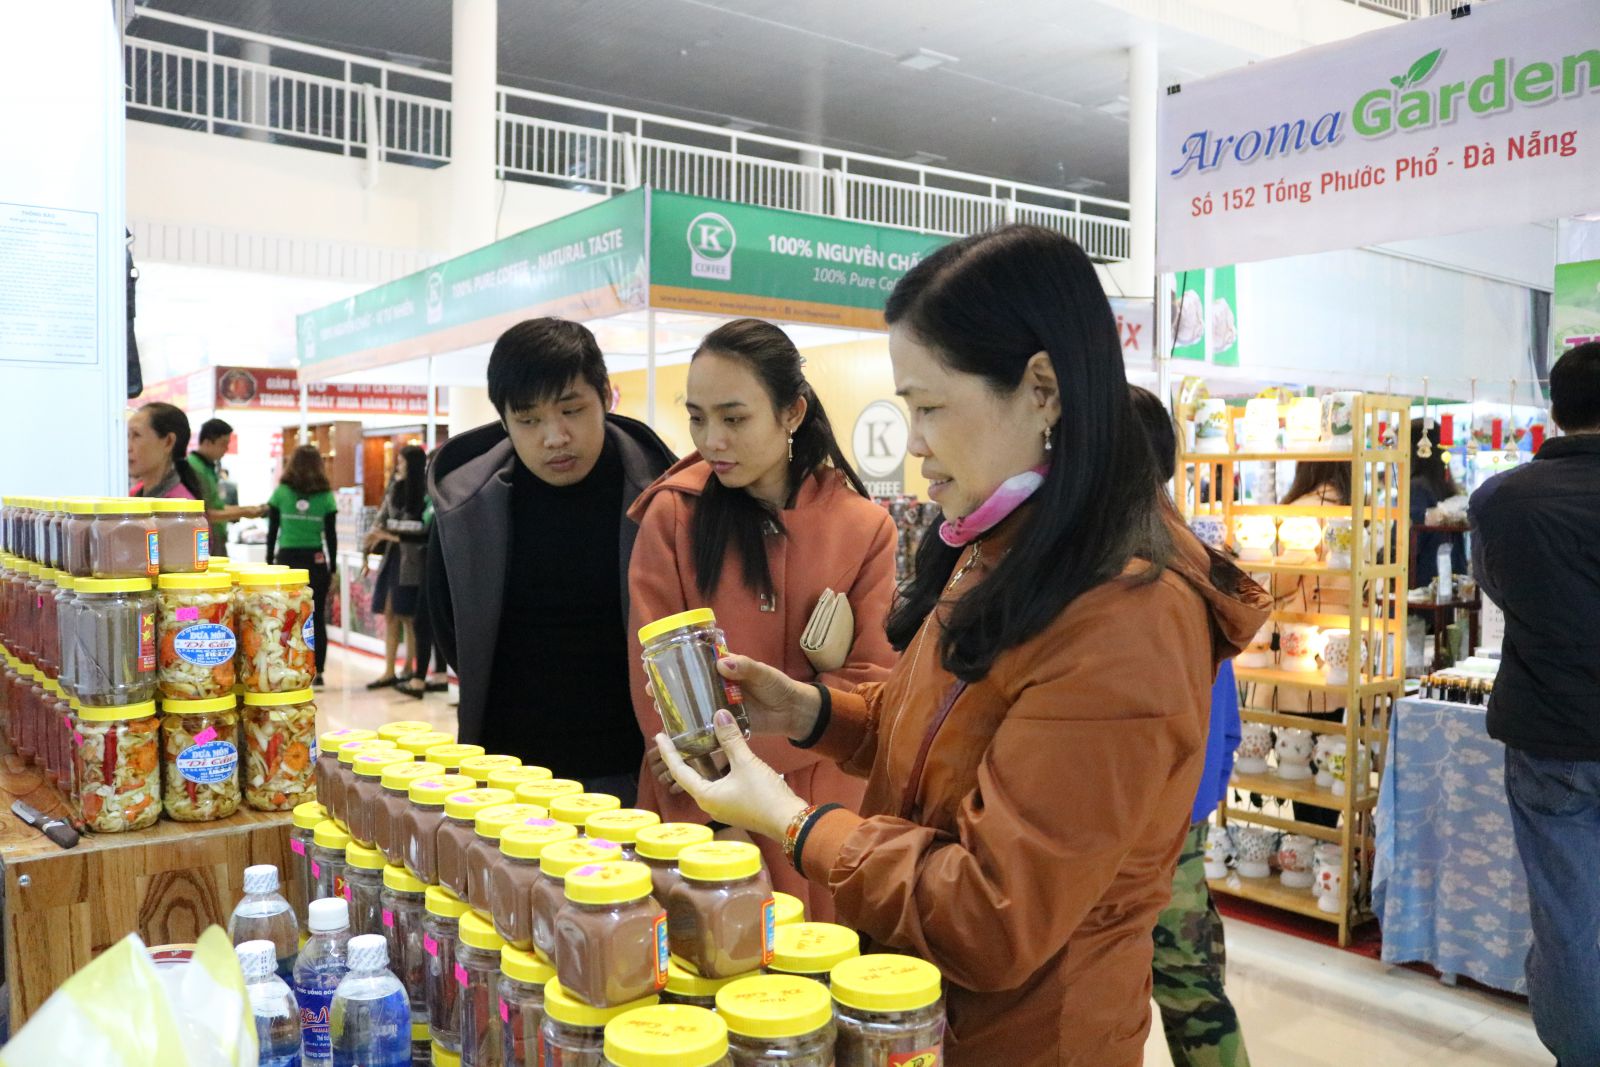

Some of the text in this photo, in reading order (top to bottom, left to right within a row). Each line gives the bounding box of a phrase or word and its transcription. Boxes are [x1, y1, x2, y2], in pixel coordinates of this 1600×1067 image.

[1170, 48, 1600, 176] Aroma Garden
[1191, 191, 1213, 217] Số
[1222, 186, 1256, 211] 152
[1321, 165, 1385, 195] Phước
[1396, 146, 1439, 181] Phổ
[1464, 142, 1495, 169] Đà
[1507, 129, 1578, 162] Nẵng
[538, 240, 587, 271] NATURAL
[588, 228, 624, 256] TASTE
[697, 223, 726, 252] K
[768, 234, 923, 272] 100% NGUYÊN CHẤ
[813, 267, 847, 285] 100%
[849, 272, 876, 289] Pure
[863, 420, 896, 458] K
